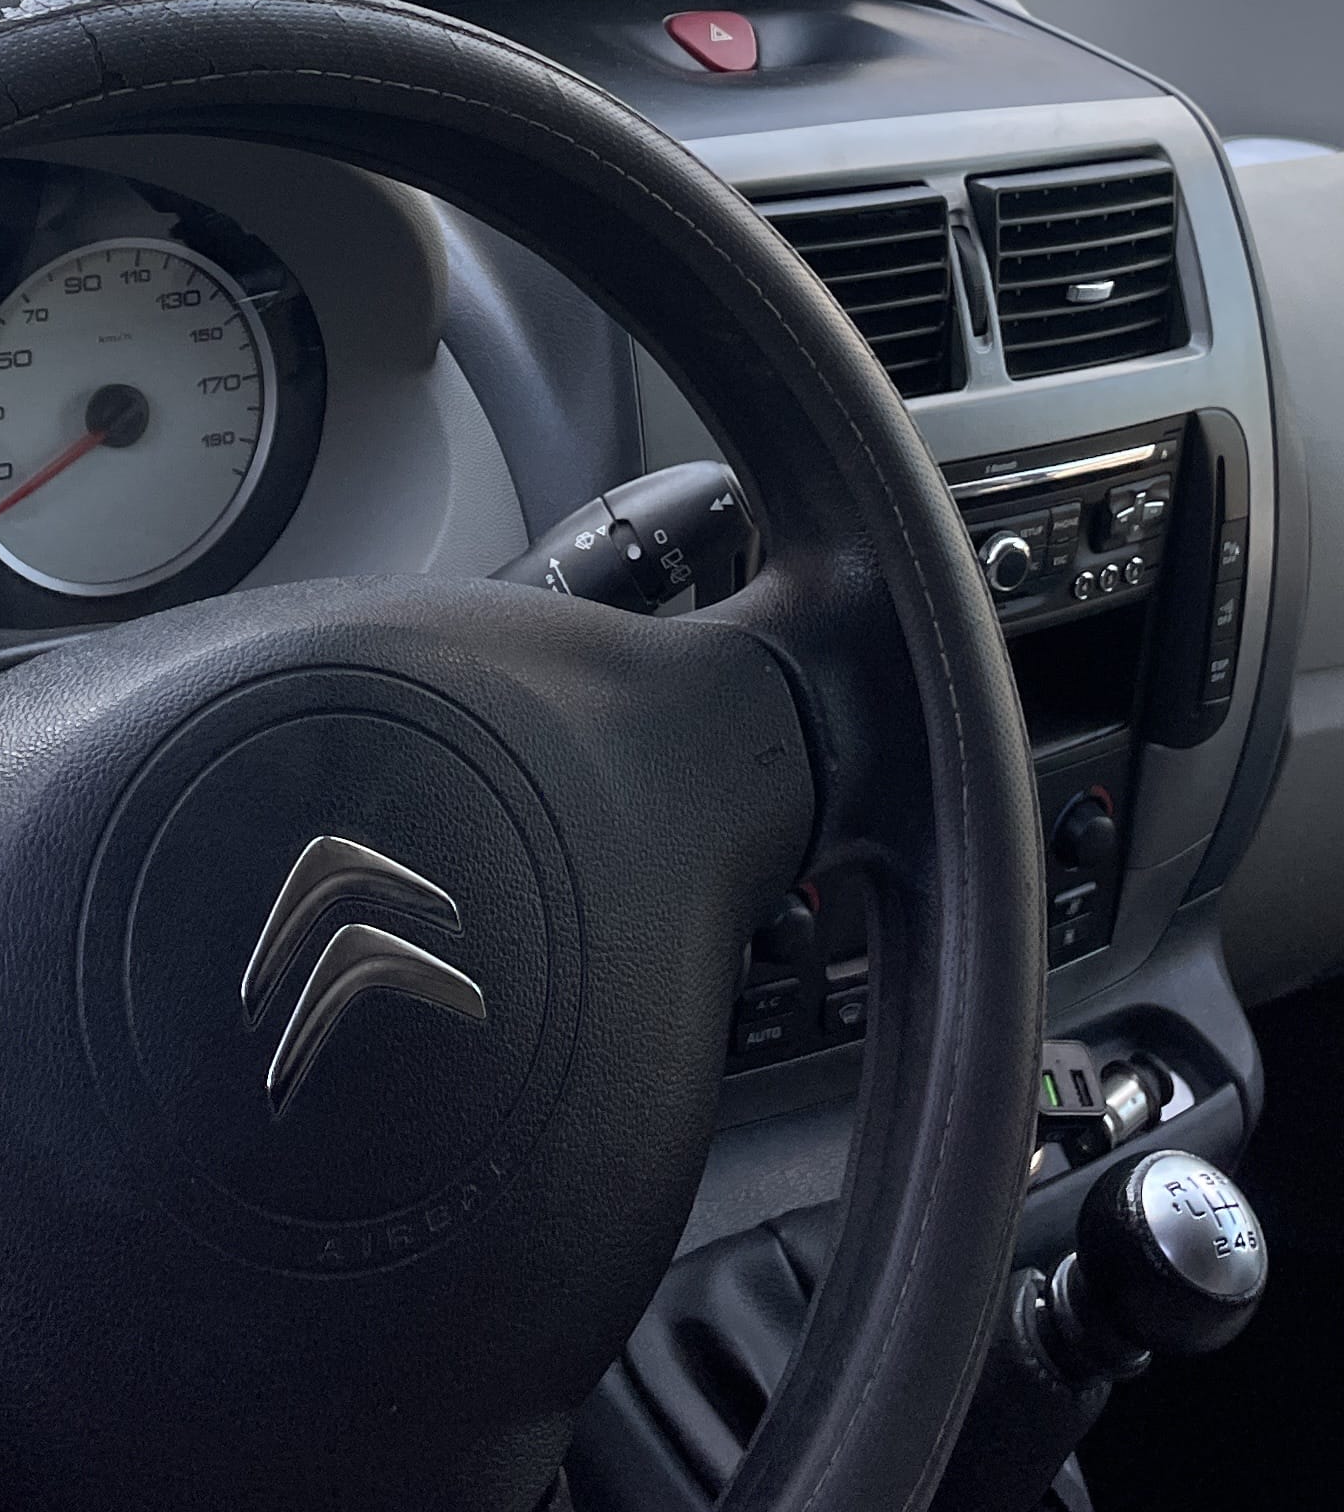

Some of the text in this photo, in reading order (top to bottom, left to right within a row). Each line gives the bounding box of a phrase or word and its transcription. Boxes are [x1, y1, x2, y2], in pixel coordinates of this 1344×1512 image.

[64, 274, 102, 295] 90
[119, 269, 151, 285] 110
[156, 290, 202, 312] 130
[22, 308, 49, 324] 70
[189, 326, 224, 344] 150
[197, 373, 242, 395] 170
[201, 431, 235, 448] 190
[747, 1027, 782, 1044] AUTO
[1164, 1181, 1187, 1196] R
[1212, 1236, 1233, 1259] 2
